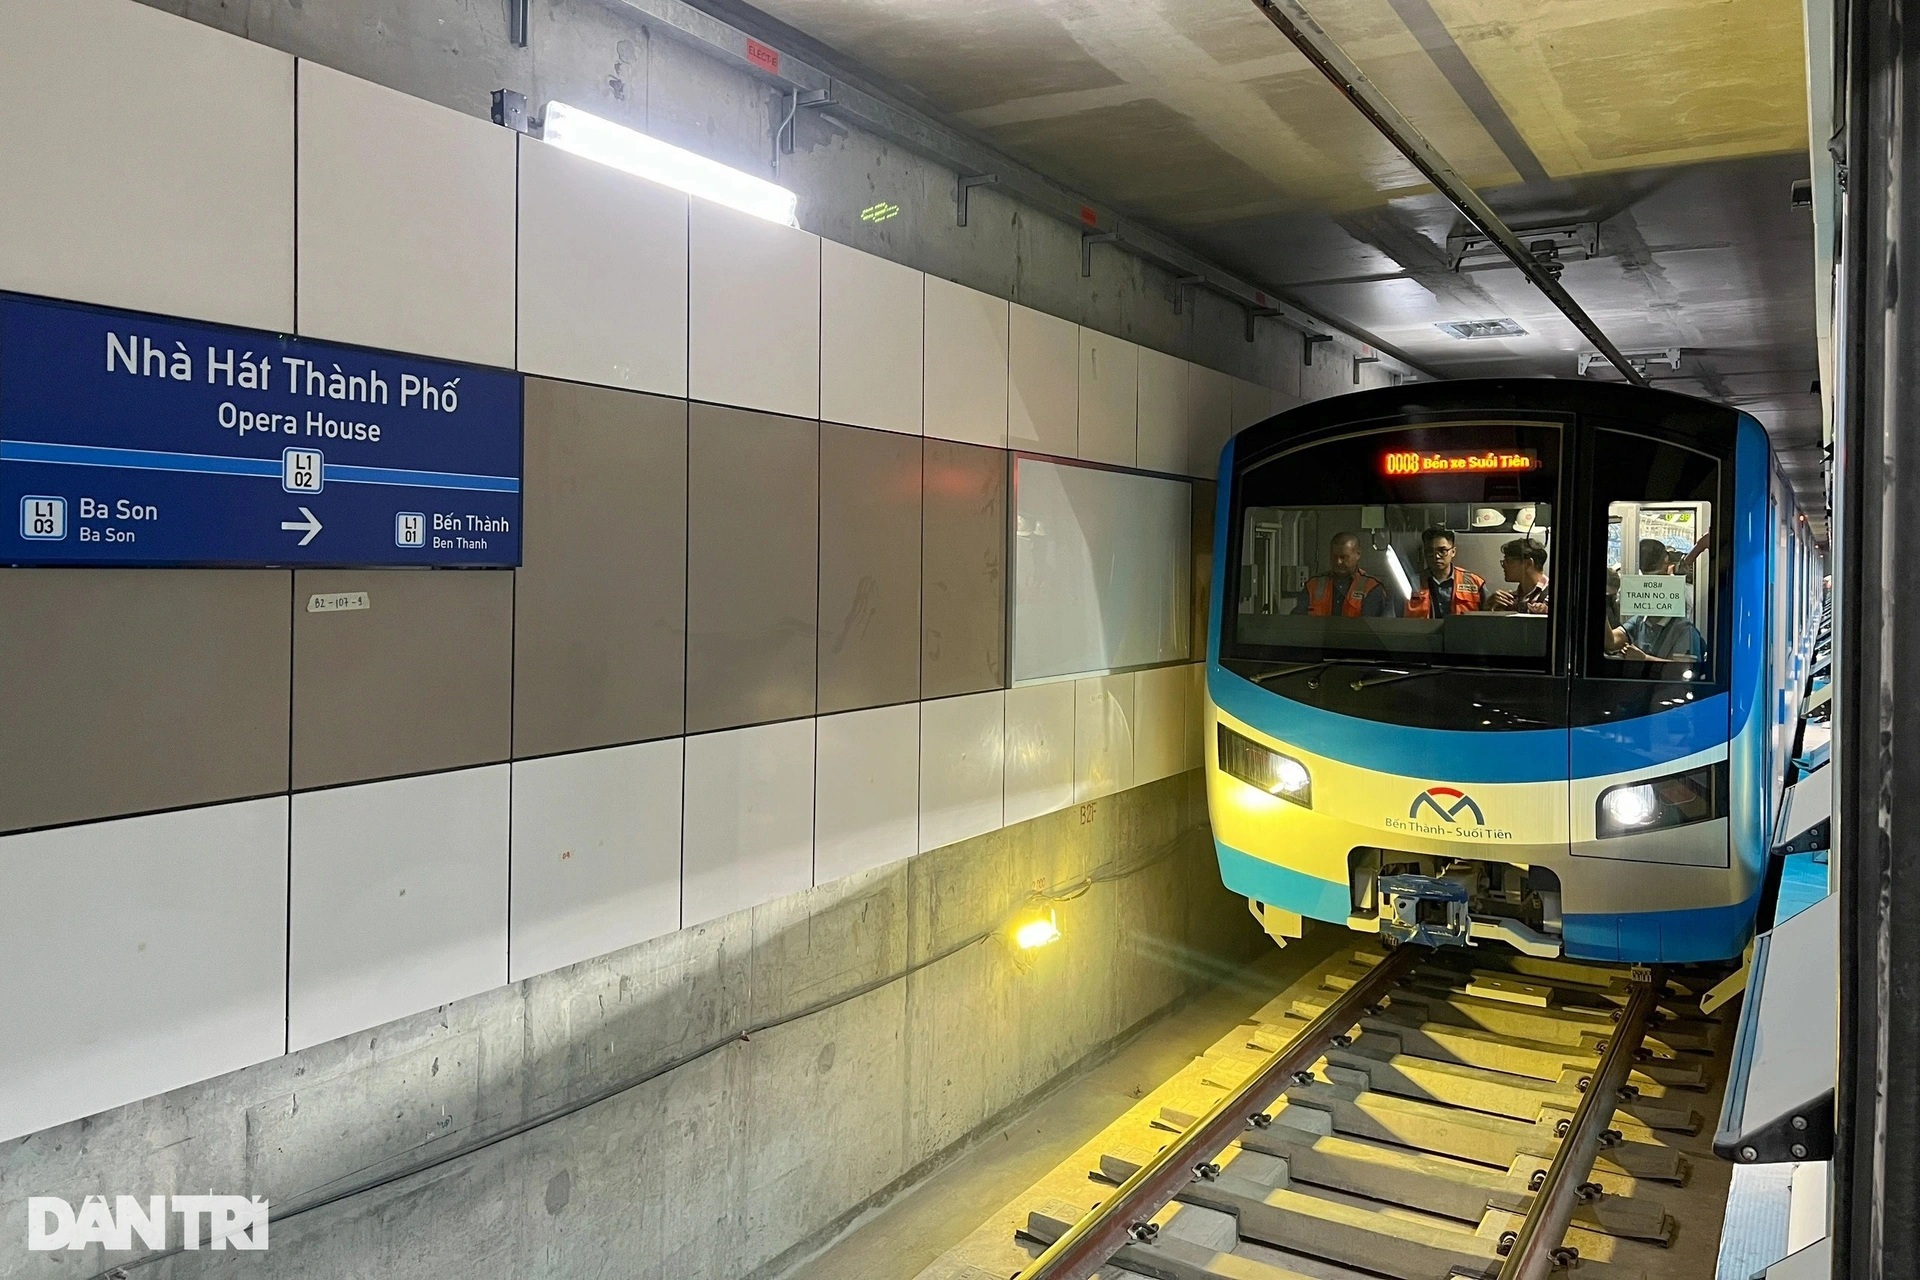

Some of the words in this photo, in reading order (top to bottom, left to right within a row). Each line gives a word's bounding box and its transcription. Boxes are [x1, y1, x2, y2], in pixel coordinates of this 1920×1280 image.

[107, 332, 192, 381] Nhà
[208, 346, 271, 390] Hát
[282, 357, 388, 405] Thành
[400, 374, 461, 412] Phố
[218, 402, 297, 436] Opera
[306, 411, 381, 442] House
[296, 454, 312, 470] L1
[1387, 453, 1419, 474] 0008
[1451, 459, 1466, 468] xe
[1500, 454, 1530, 467] Tiên
[295, 471, 312, 487] 02
[35, 502, 53, 517] L1
[80, 498, 108, 519] Ba
[116, 499, 158, 520] Son
[34, 519, 54, 534] 03
[405, 517, 417, 529] L1
[433, 512, 461, 531] Bến
[466, 515, 509, 532] Thành
[80, 527, 100, 541] Ba
[105, 528, 135, 542] Son
[405, 531, 416, 543] 01
[433, 536, 453, 549] Ben
[456, 537, 488, 549] Thanh
[1670, 592, 1680, 600] 08
[1656, 602, 1672, 610] CAR
[1385, 817, 1406, 830] Bến
[1408, 821, 1445, 835] Thành
[1455, 826, 1483, 839] Suối
[1485, 828, 1513, 839] Tiên
